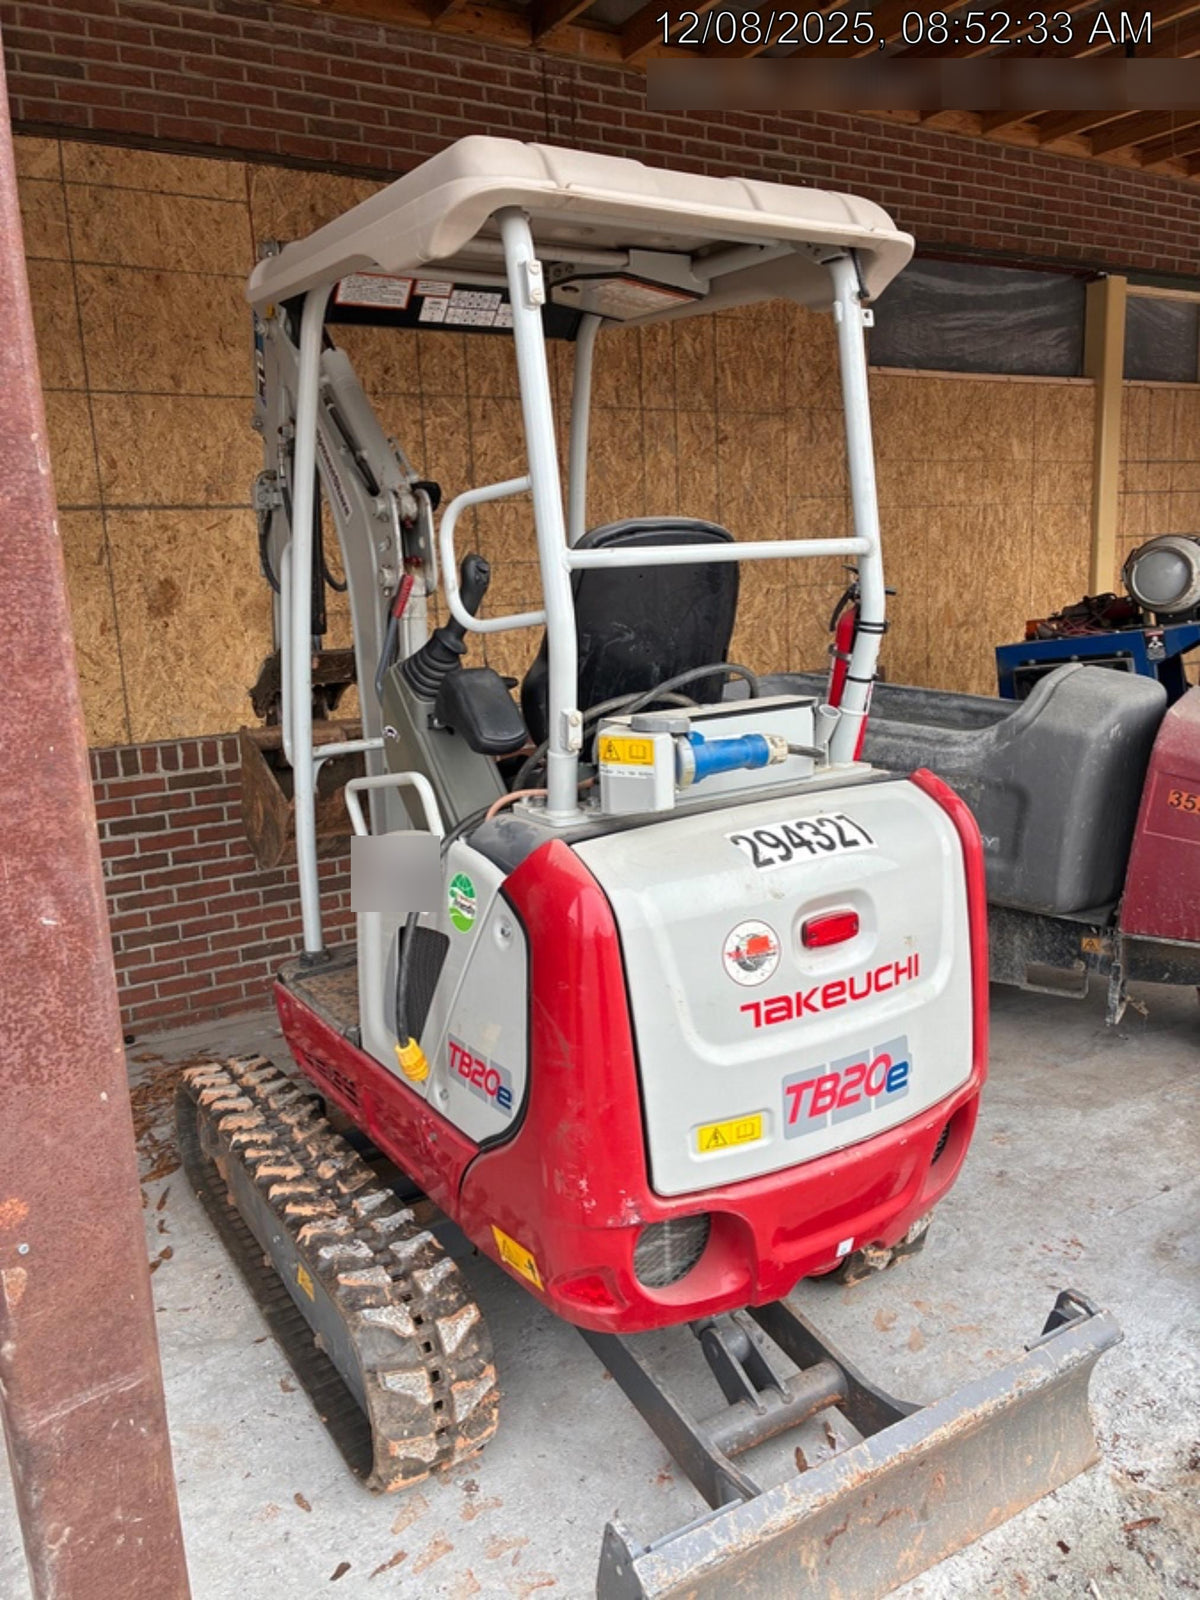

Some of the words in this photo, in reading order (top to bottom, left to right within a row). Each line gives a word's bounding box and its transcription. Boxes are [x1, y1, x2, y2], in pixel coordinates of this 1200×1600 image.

[1170, 790, 1200, 813] 35
[730, 814, 874, 868] 294327
[448, 1041, 512, 1110] TB20e
[785, 1053, 909, 1124] TB20e
